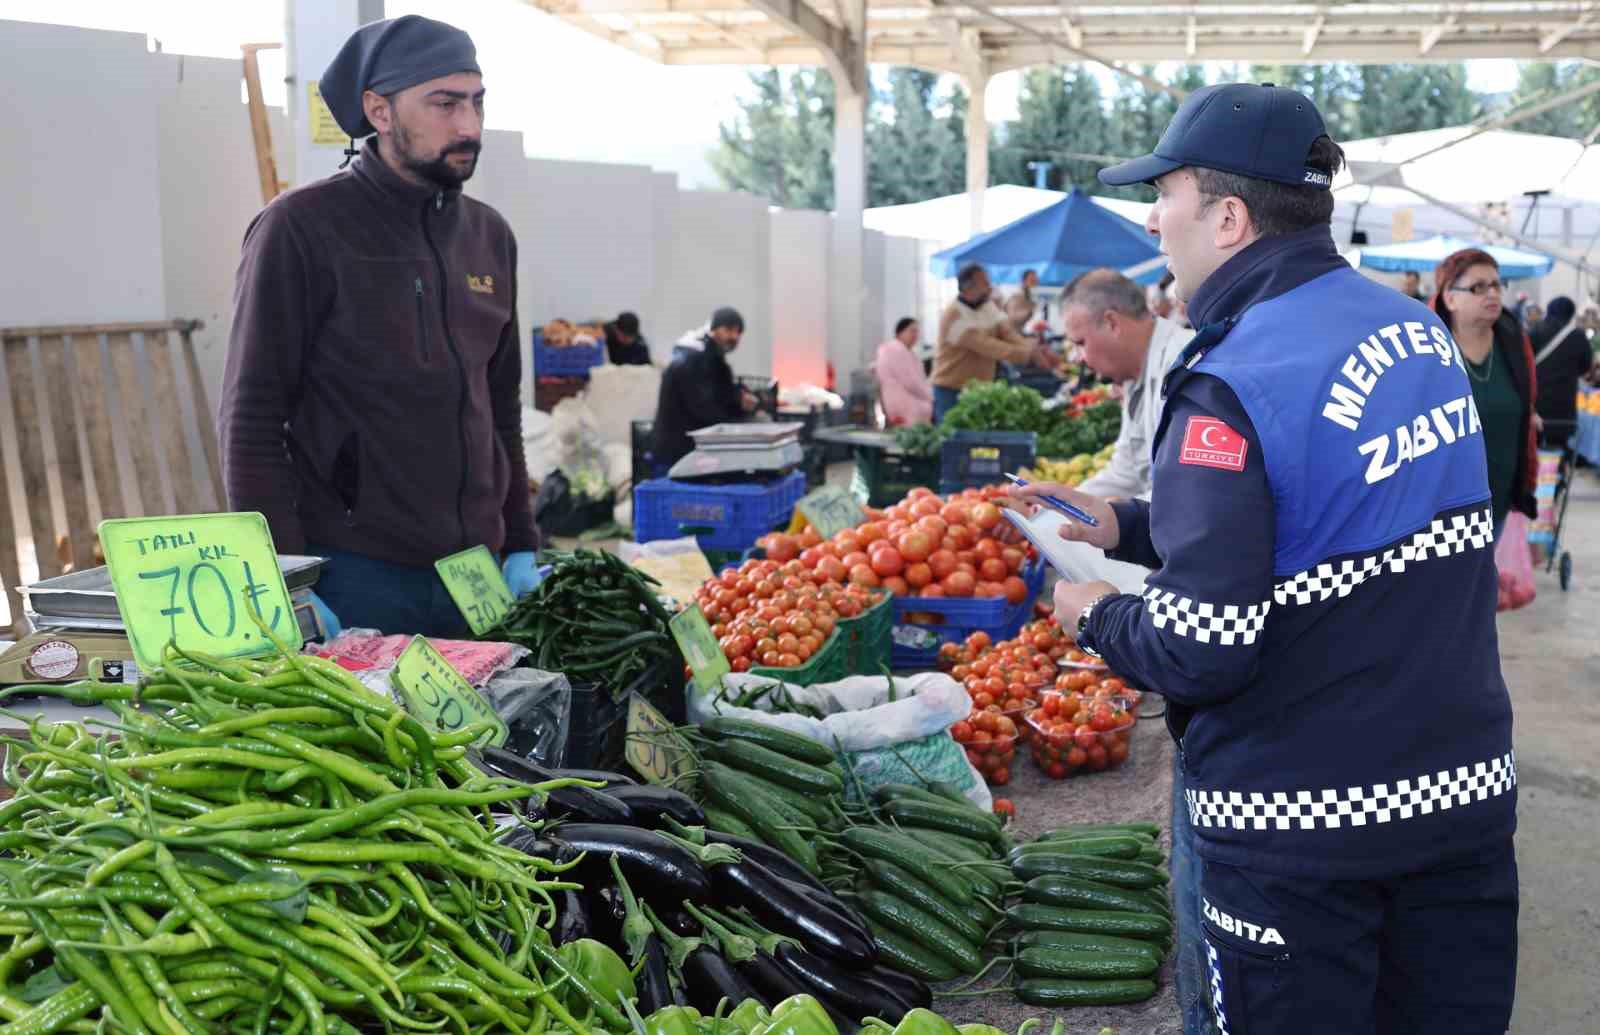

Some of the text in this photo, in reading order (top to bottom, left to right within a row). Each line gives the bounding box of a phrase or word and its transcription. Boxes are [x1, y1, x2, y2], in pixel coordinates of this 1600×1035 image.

[1358, 394, 1483, 485] ZABITA
[125, 531, 195, 555] TATLI
[415, 671, 464, 729] 50
[1203, 897, 1286, 945] ZABITA
